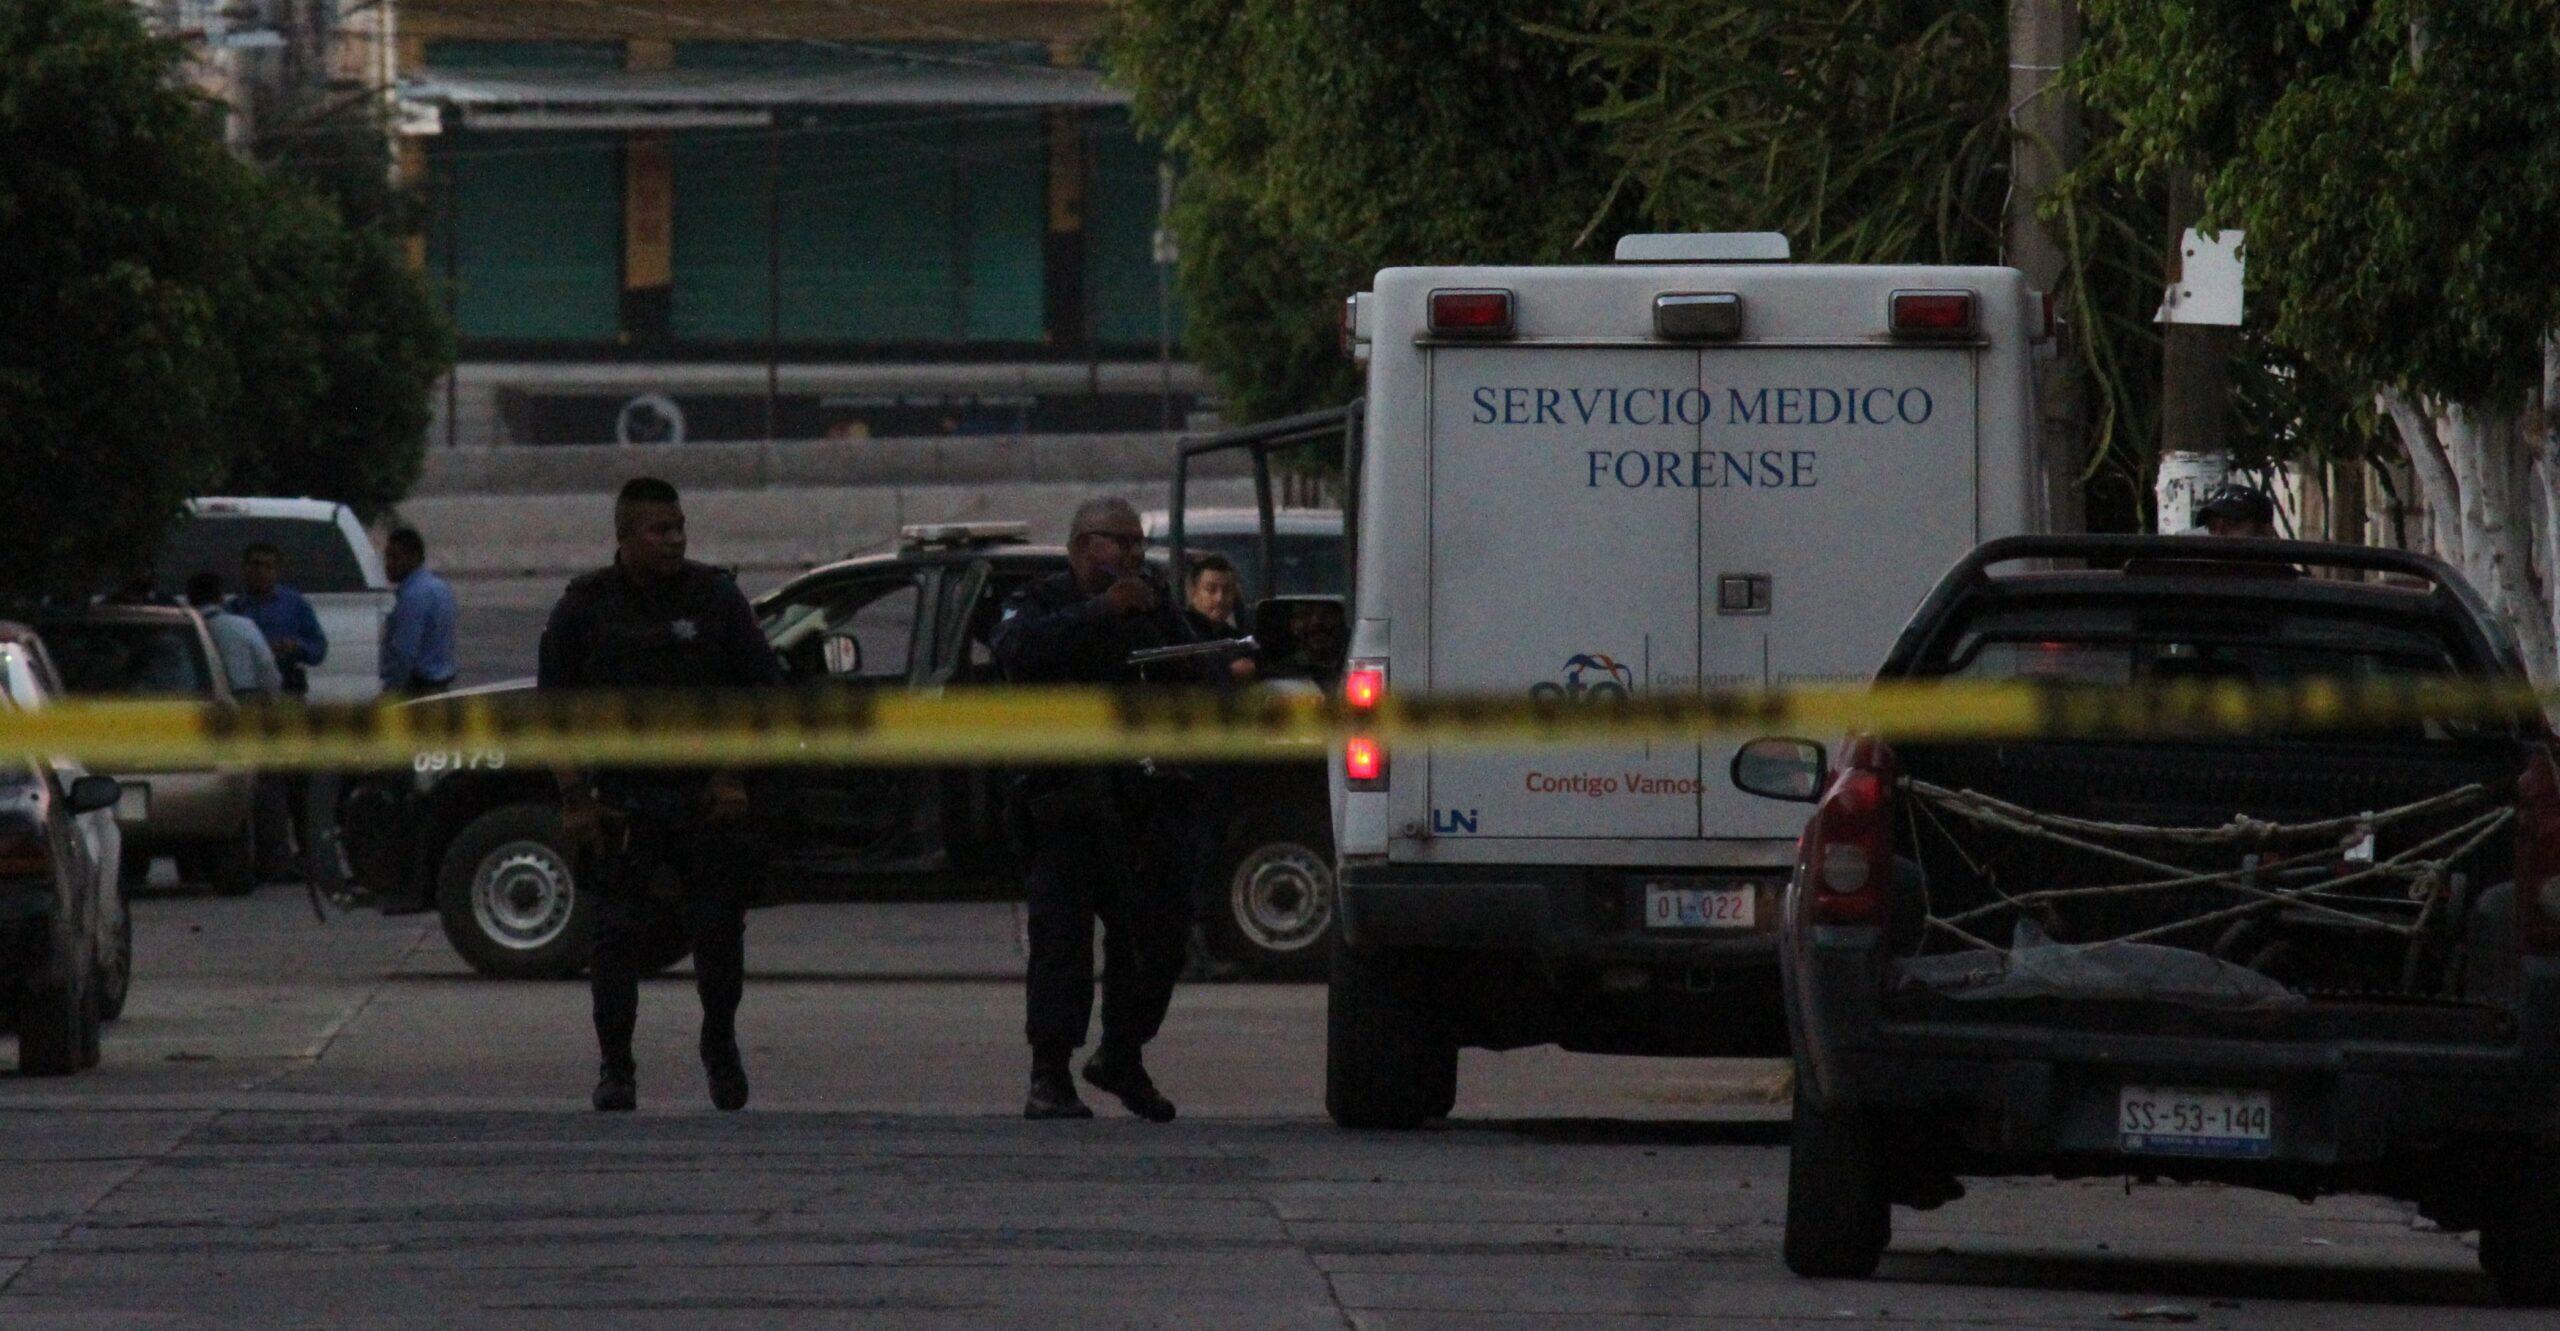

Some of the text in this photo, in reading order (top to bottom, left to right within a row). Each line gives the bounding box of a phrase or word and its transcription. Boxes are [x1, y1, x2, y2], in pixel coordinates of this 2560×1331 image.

[1473, 387, 1933, 425] SERVICIO MEDICO
[1586, 450, 1819, 488] FORENSE
[413, 750, 506, 772] 09179
[1525, 772, 1706, 797] Contigo Vamos
[2126, 1100, 2266, 1134] SS-53-144
